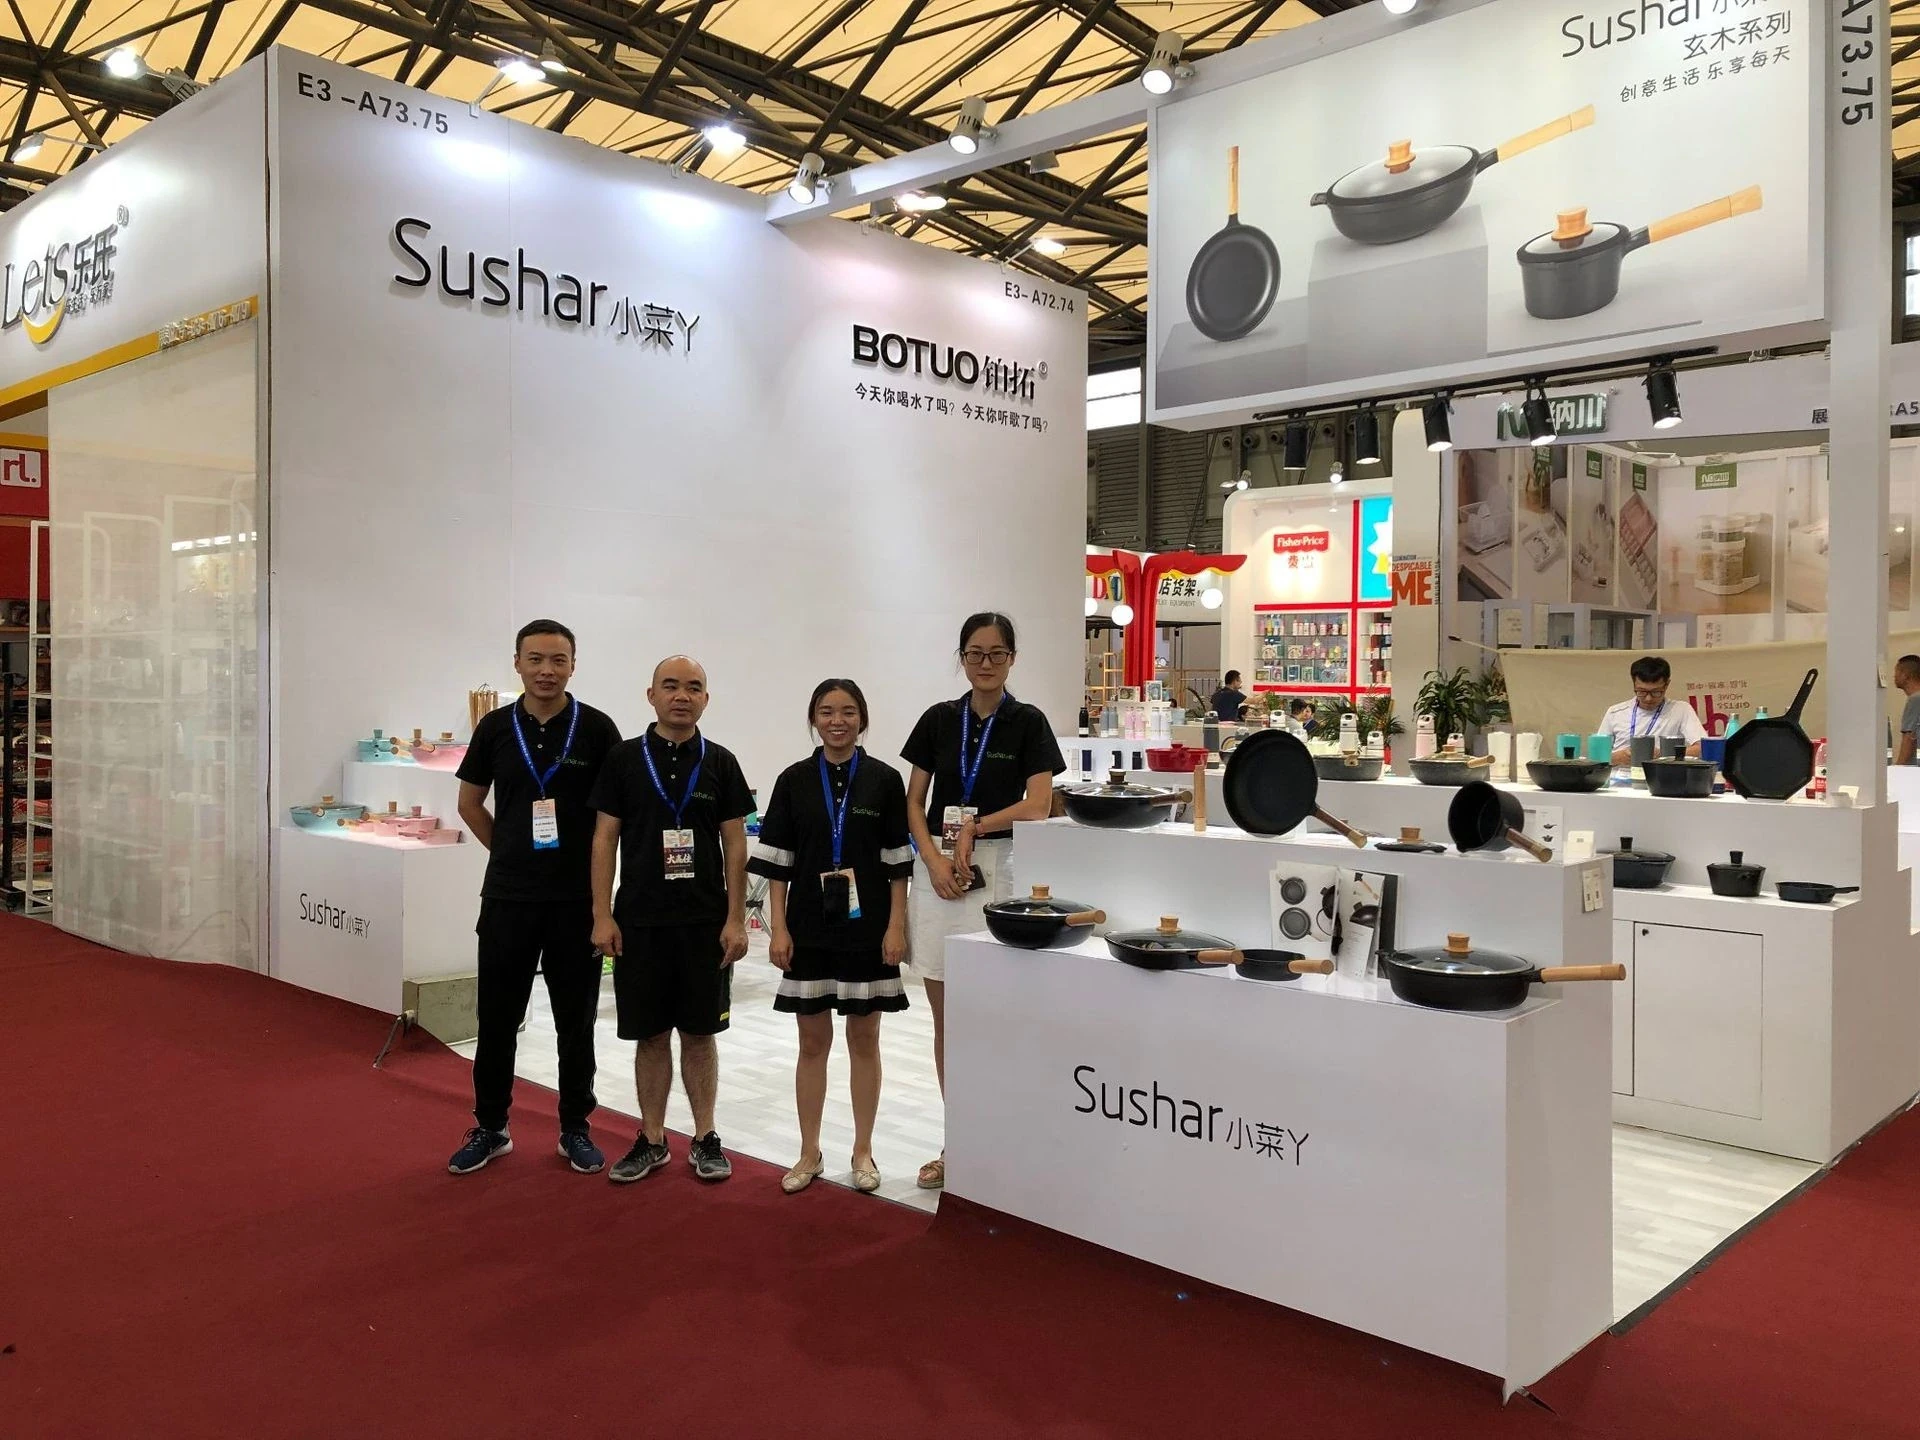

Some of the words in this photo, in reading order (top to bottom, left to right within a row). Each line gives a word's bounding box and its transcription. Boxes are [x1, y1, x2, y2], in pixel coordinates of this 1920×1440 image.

[1683, 10, 1791, 60] 玄木系列
[1620, 45, 1791, 103] 创意生活乐享每天
[394, 217, 608, 327] Sushar
[610, 296, 700, 352] 小菜丫
[1005, 281, 1075, 314] E3-A72.74
[853, 324, 979, 385] BOTUO
[1277, 535, 1325, 548] Fisher-Price
[1158, 578, 1197, 597] 店货架
[1392, 571, 1432, 606] ME
[300, 893, 346, 930] Sushar
[1073, 1064, 1223, 1142] Sushar
[1226, 1117, 1309, 1166] 小菜丫
